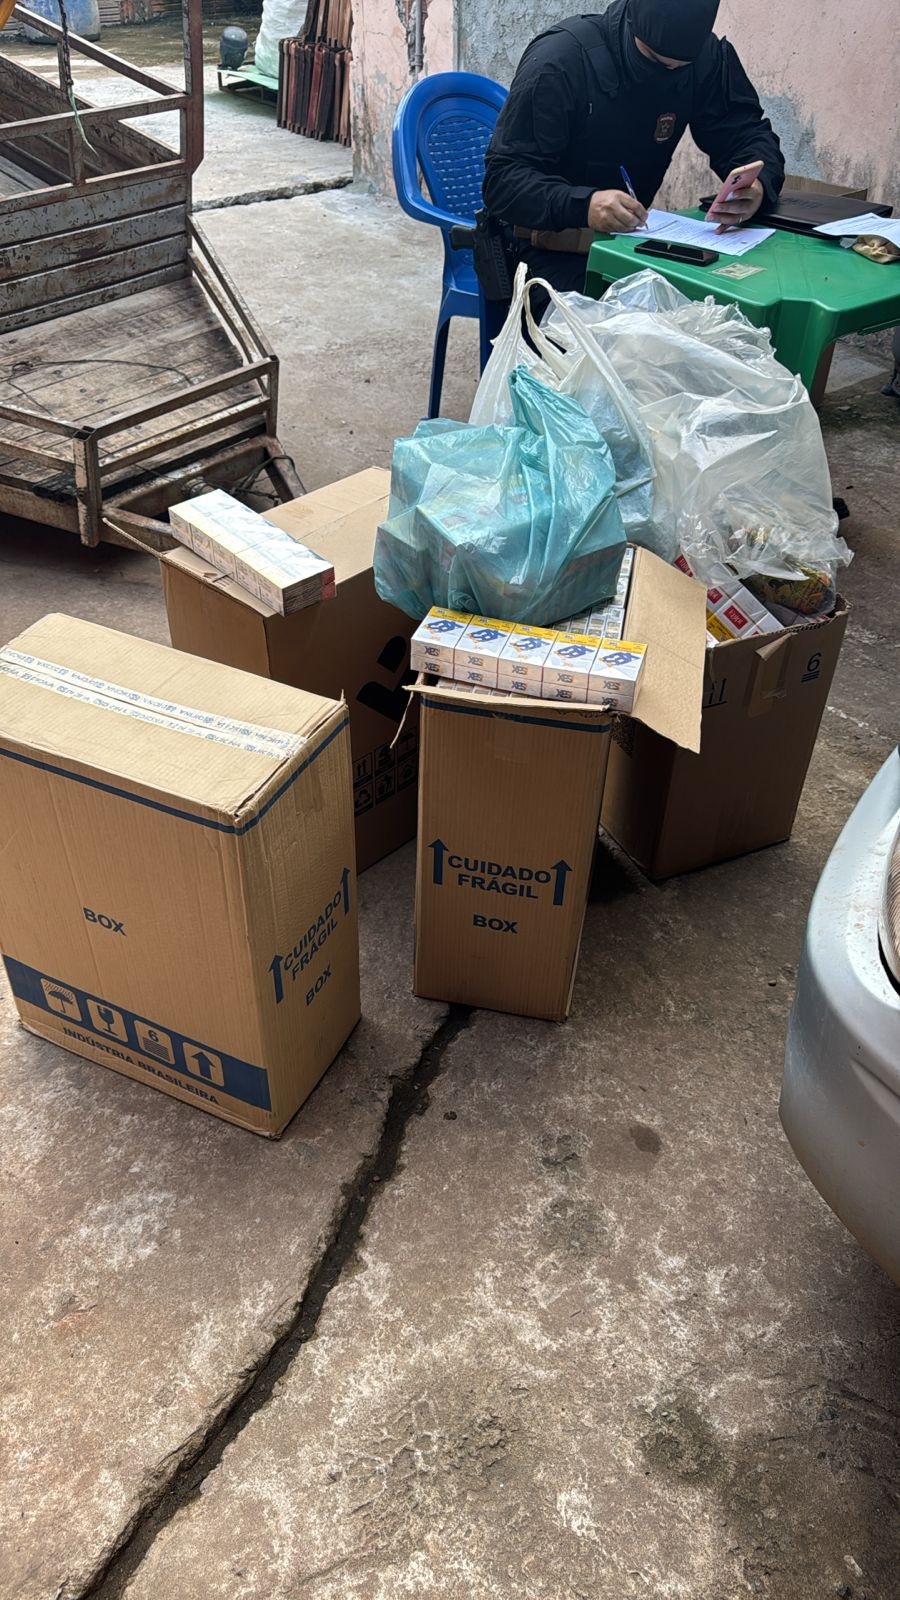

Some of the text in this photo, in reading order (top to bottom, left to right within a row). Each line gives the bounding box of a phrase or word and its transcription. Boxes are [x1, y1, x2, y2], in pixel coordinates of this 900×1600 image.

[807, 652, 822, 672] 6
[447, 855, 552, 884] CUIDADO
[458, 874, 538, 899] FRÁGIL
[83, 907, 127, 936] BOX
[283, 891, 341, 971] CUIDADO
[473, 914, 518, 934] BOX
[292, 918, 338, 981] FRÁGIL
[306, 964, 332, 1007] BOX
[148, 1029, 160, 1042] 6
[63, 1027, 219, 1105] INDÚSTRIA BRASILEIRA
